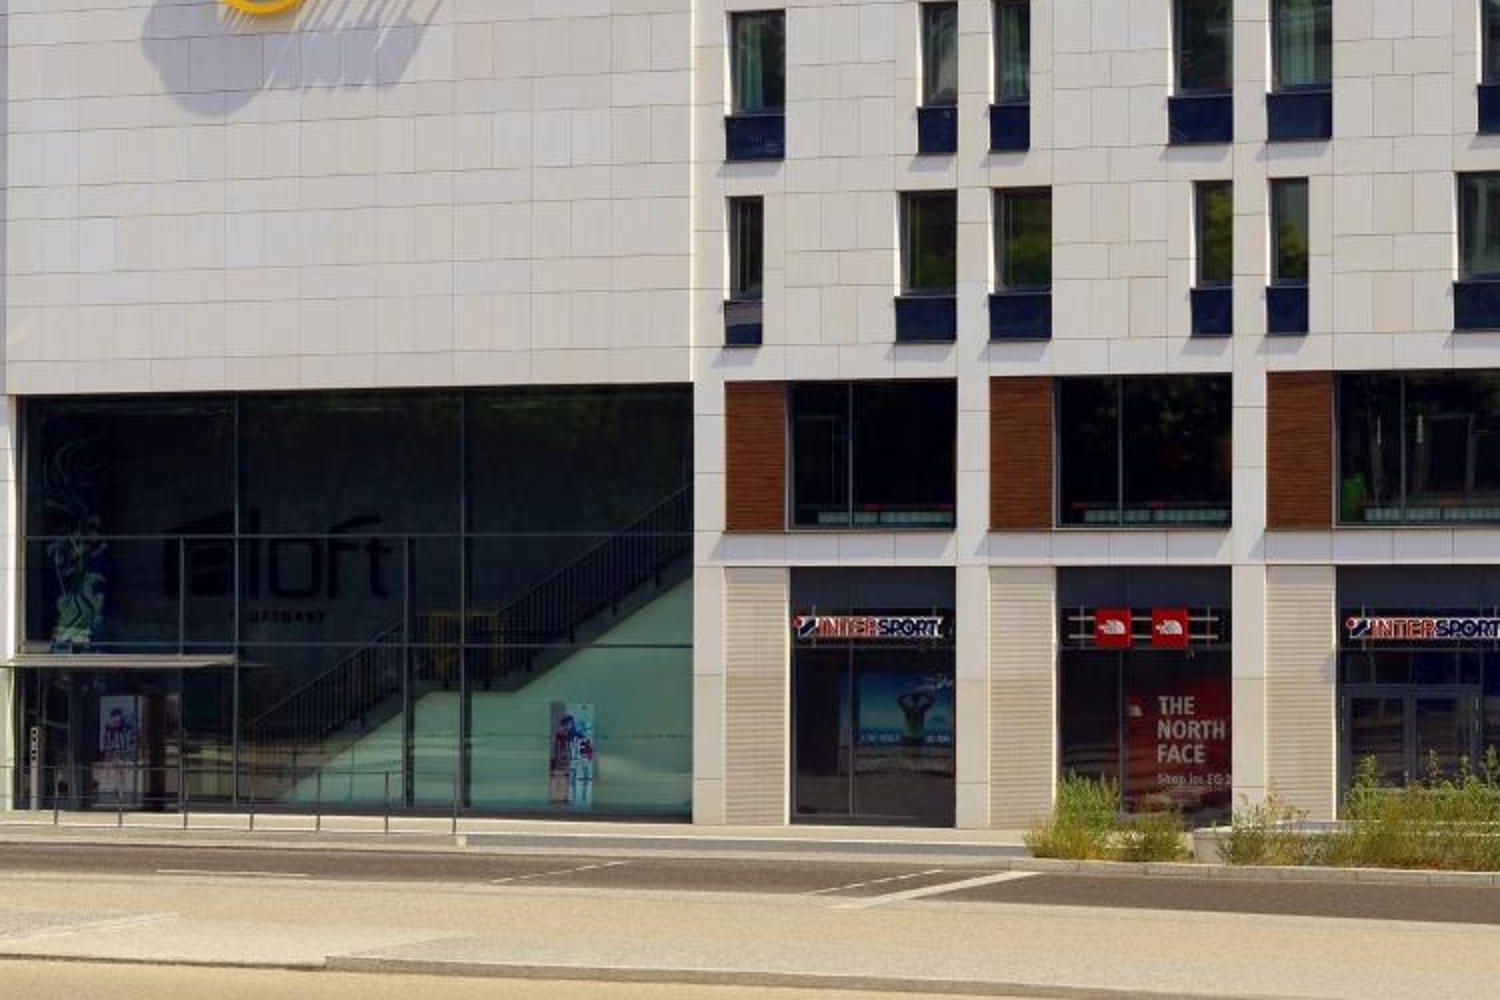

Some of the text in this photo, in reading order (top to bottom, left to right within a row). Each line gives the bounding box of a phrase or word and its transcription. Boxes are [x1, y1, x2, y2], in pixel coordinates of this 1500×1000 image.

[817, 616, 940, 637] INTERSPORT
[1157, 695, 1195, 715] THE
[1157, 719, 1225, 740] NORTH
[1157, 743, 1206, 763] FACE
